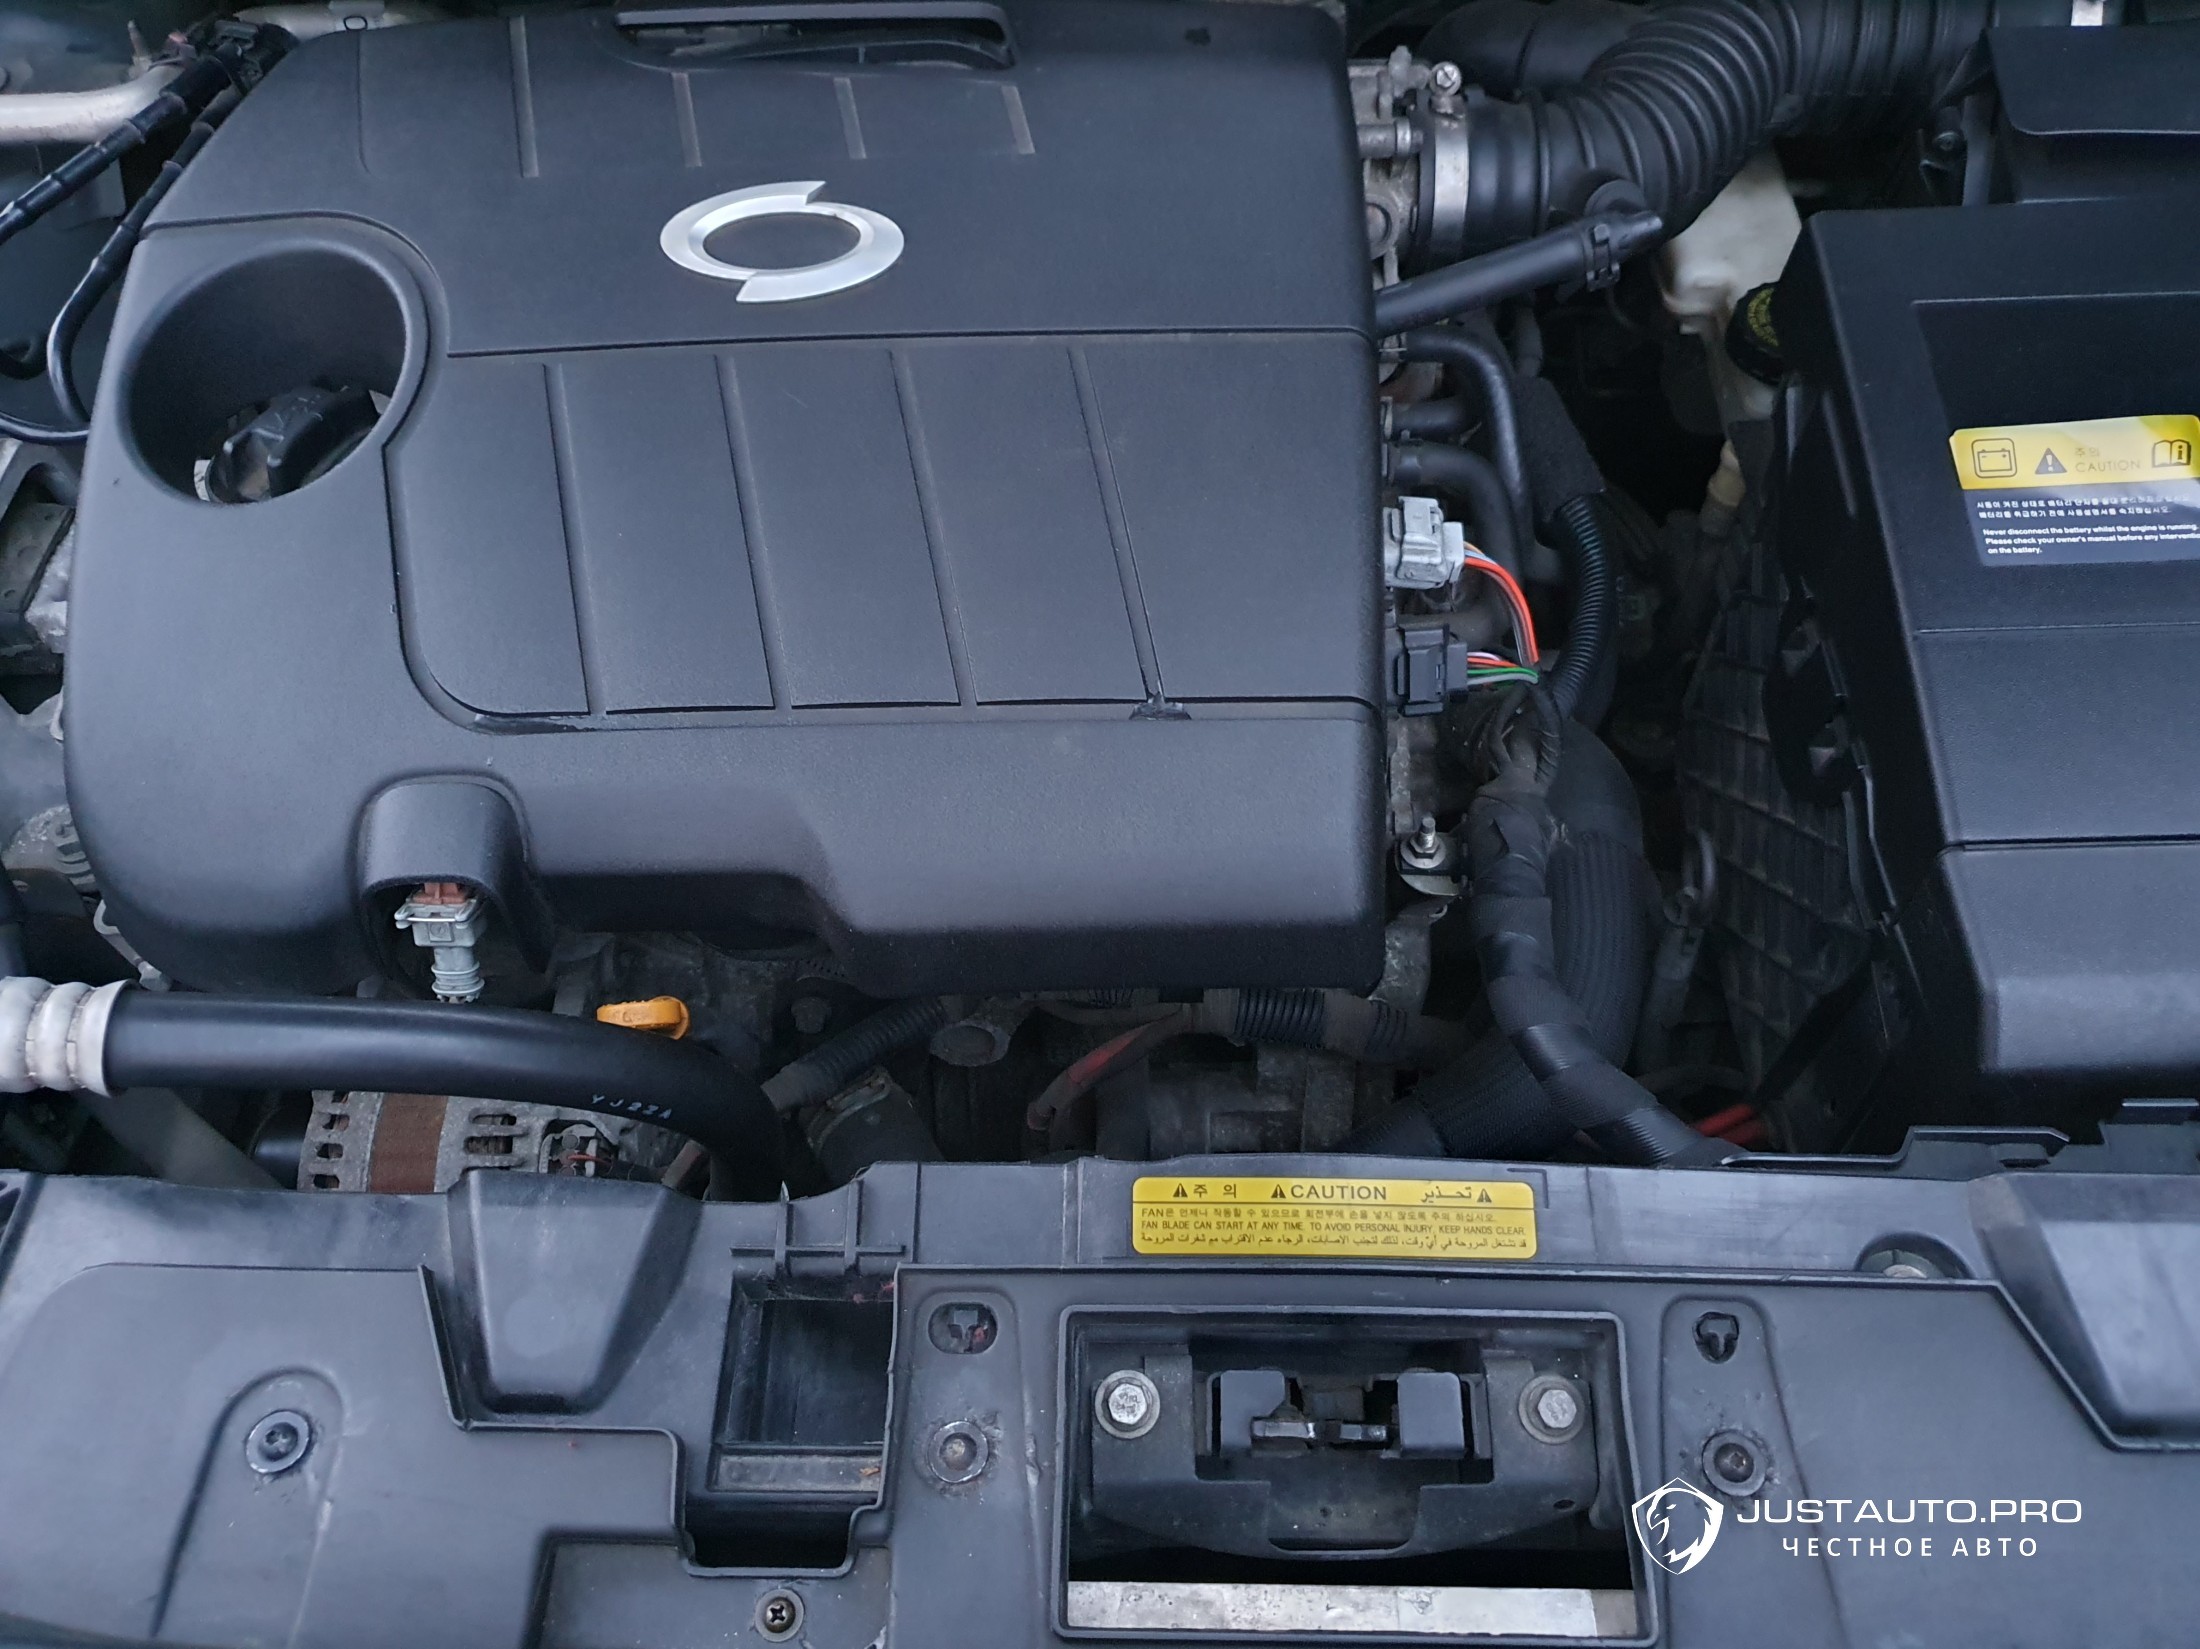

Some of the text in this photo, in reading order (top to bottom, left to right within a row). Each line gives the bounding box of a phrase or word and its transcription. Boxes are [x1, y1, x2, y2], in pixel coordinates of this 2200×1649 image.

[2075, 460, 2140, 472] CAUTION
[1982, 528, 2006, 536] Never
[2007, 527, 2050, 535] disconnect
[2064, 526, 2091, 535] battery
[2093, 525, 2116, 533] whilst
[2131, 525, 2157, 533] engine
[1985, 537, 2012, 545] Please
[2037, 537, 2055, 545] your
[2056, 535, 2086, 543] owner's
[2087, 534, 2116, 542] manual
[2144, 534, 2159, 542] any
[2012, 546, 2043, 554] battery.
[1290, 1185, 1387, 1200] CAUTION
[1141, 1207, 1174, 1218] FAN은
[1179, 1207, 1208, 1218] 언제나
[1247, 1208, 1257, 1218] 수
[1260, 1208, 1300, 1218] 있으므로
[1349, 1210, 1368, 1220] 손을
[1431, 1211, 1450, 1222] 주의
[1141, 1220, 1158, 1229] FAN
[1162, 1220, 1190, 1230] BLADE
[1193, 1221, 1212, 1230] CAN
[1216, 1221, 1244, 1230] START
[1246, 1221, 1258, 1230] AT
[1261, 1221, 1279, 1230] ANY
[1309, 1222, 1322, 1231] TO
[1324, 1222, 1351, 1232] AVOID
[1354, 1223, 1400, 1232] PERSONAL
[1439, 1224, 1461, 1234] KEEP
[1463, 1225, 1493, 1235] HANDS
